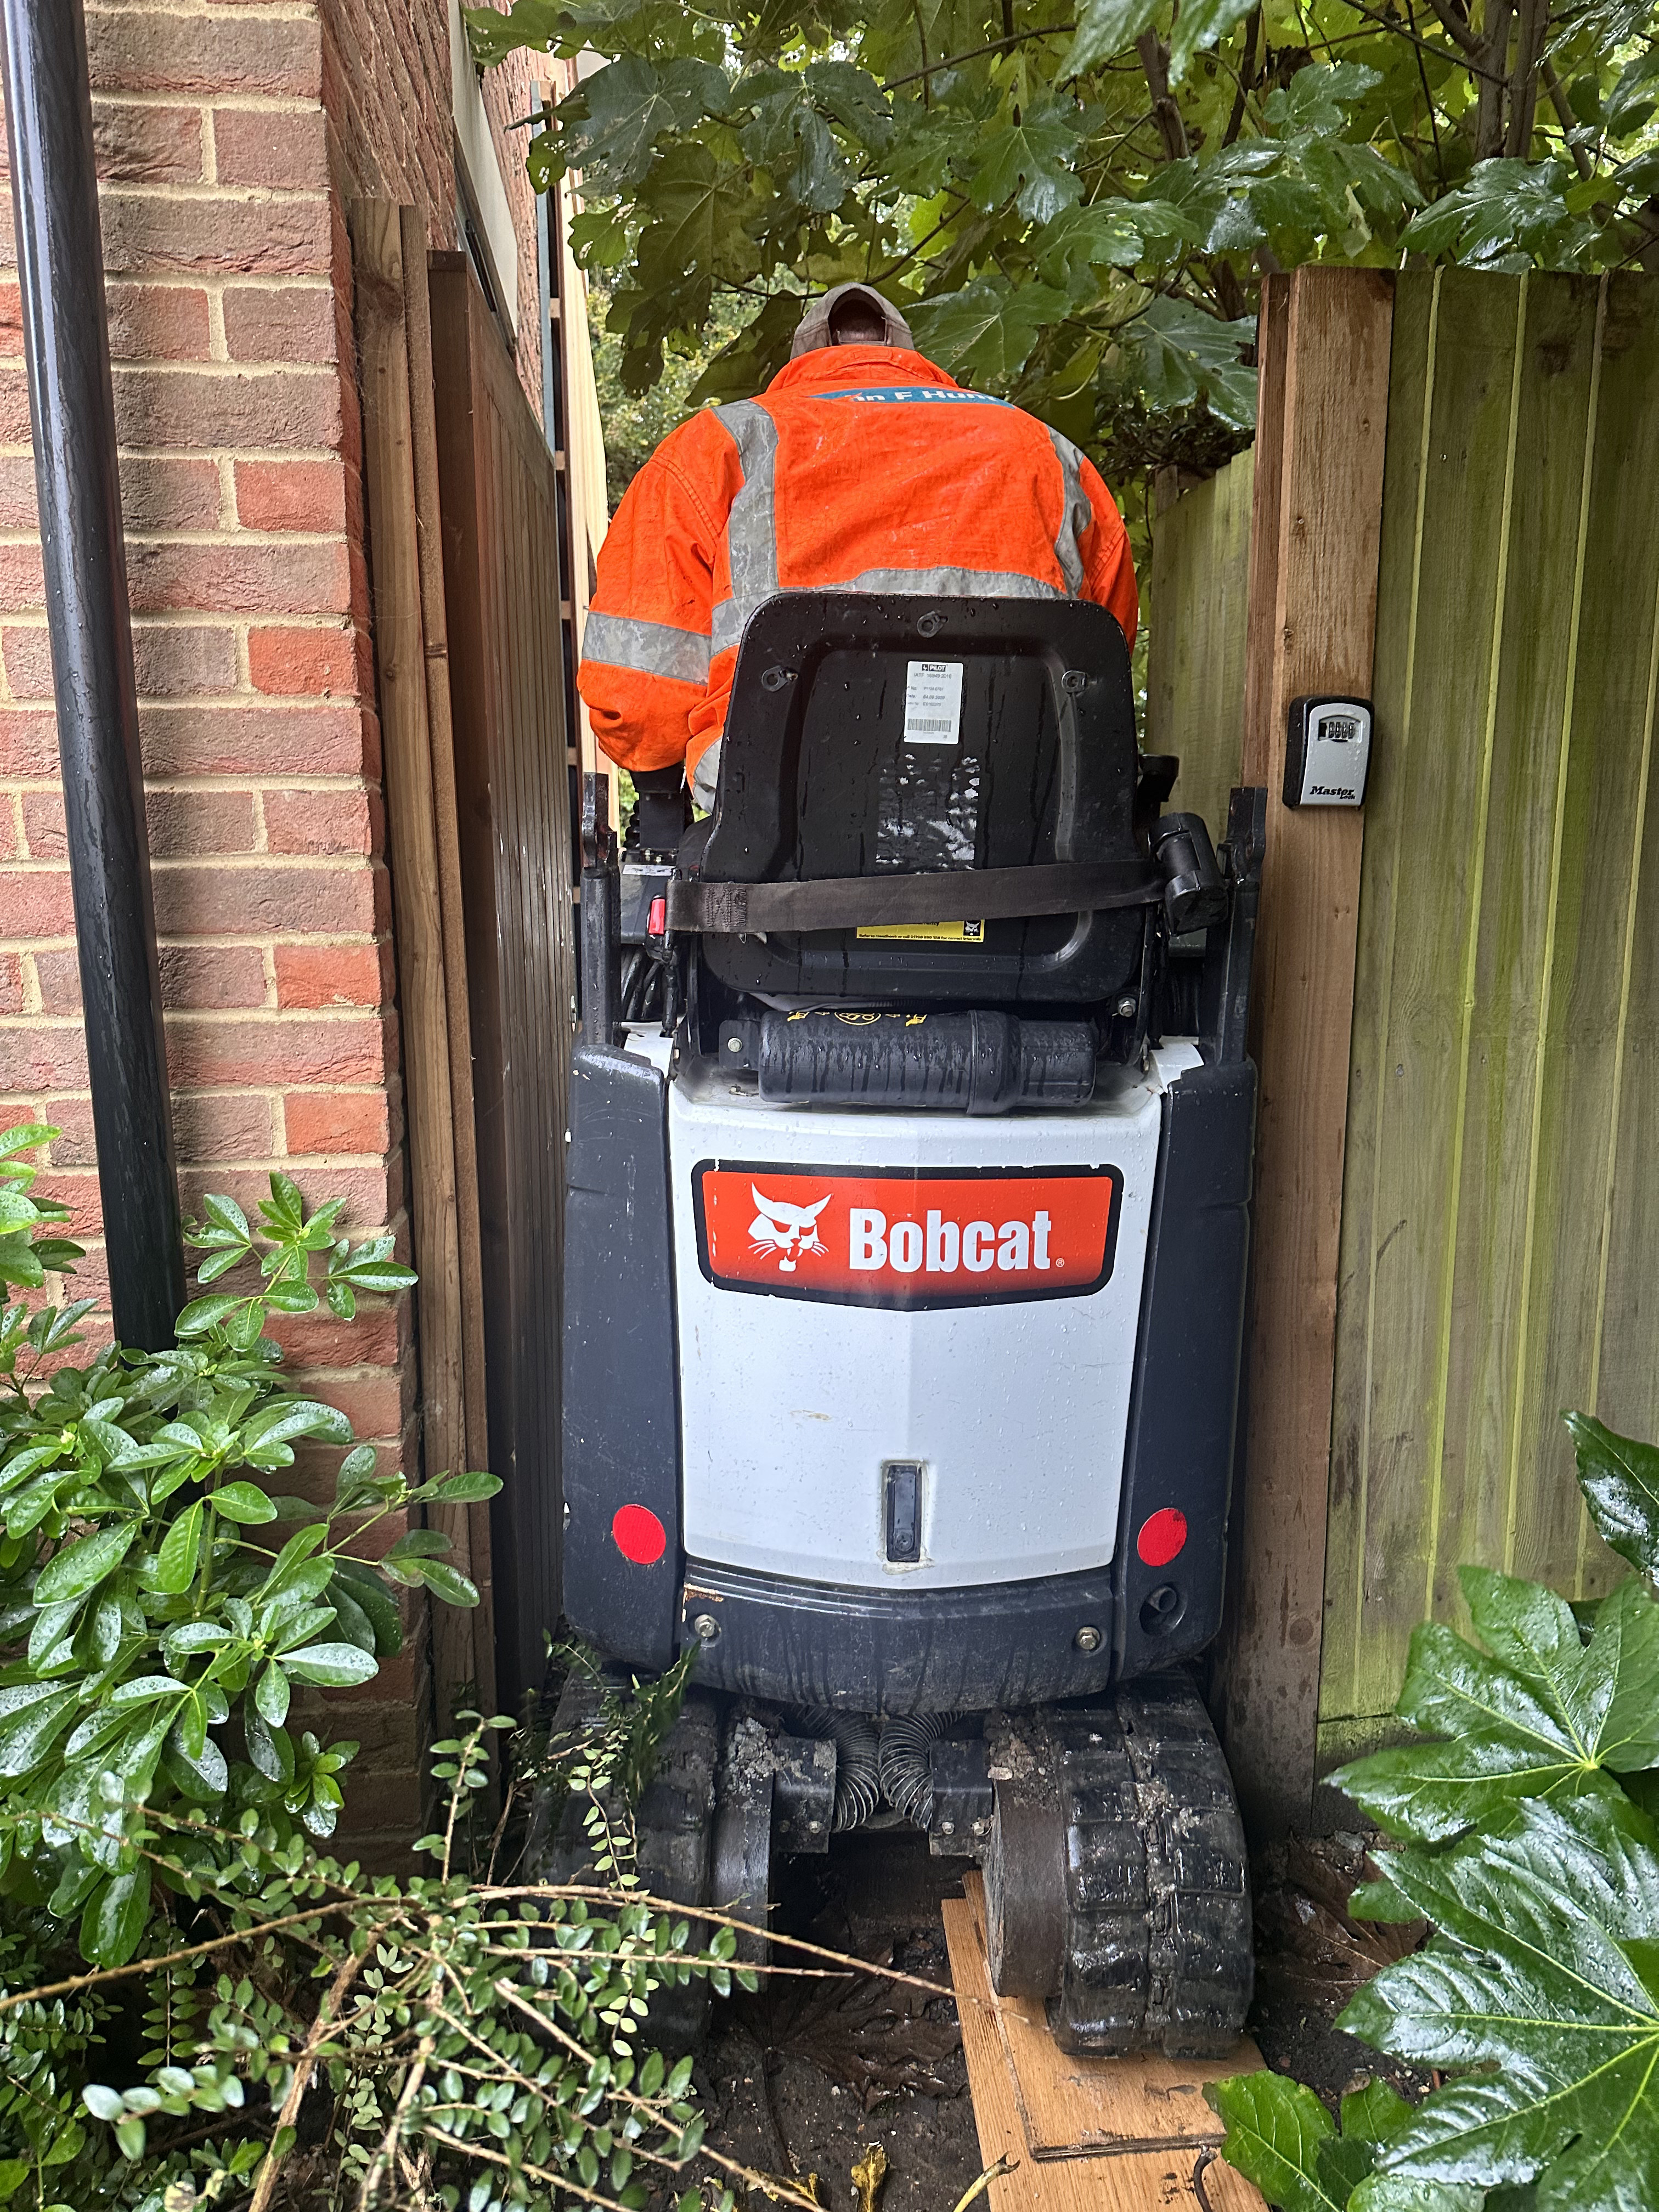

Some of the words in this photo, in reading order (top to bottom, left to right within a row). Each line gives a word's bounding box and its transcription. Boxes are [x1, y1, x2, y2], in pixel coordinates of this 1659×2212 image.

[894, 391, 913, 400] F
[1309, 786, 1355, 795] Master
[849, 1207, 1053, 1273] Bobcat
